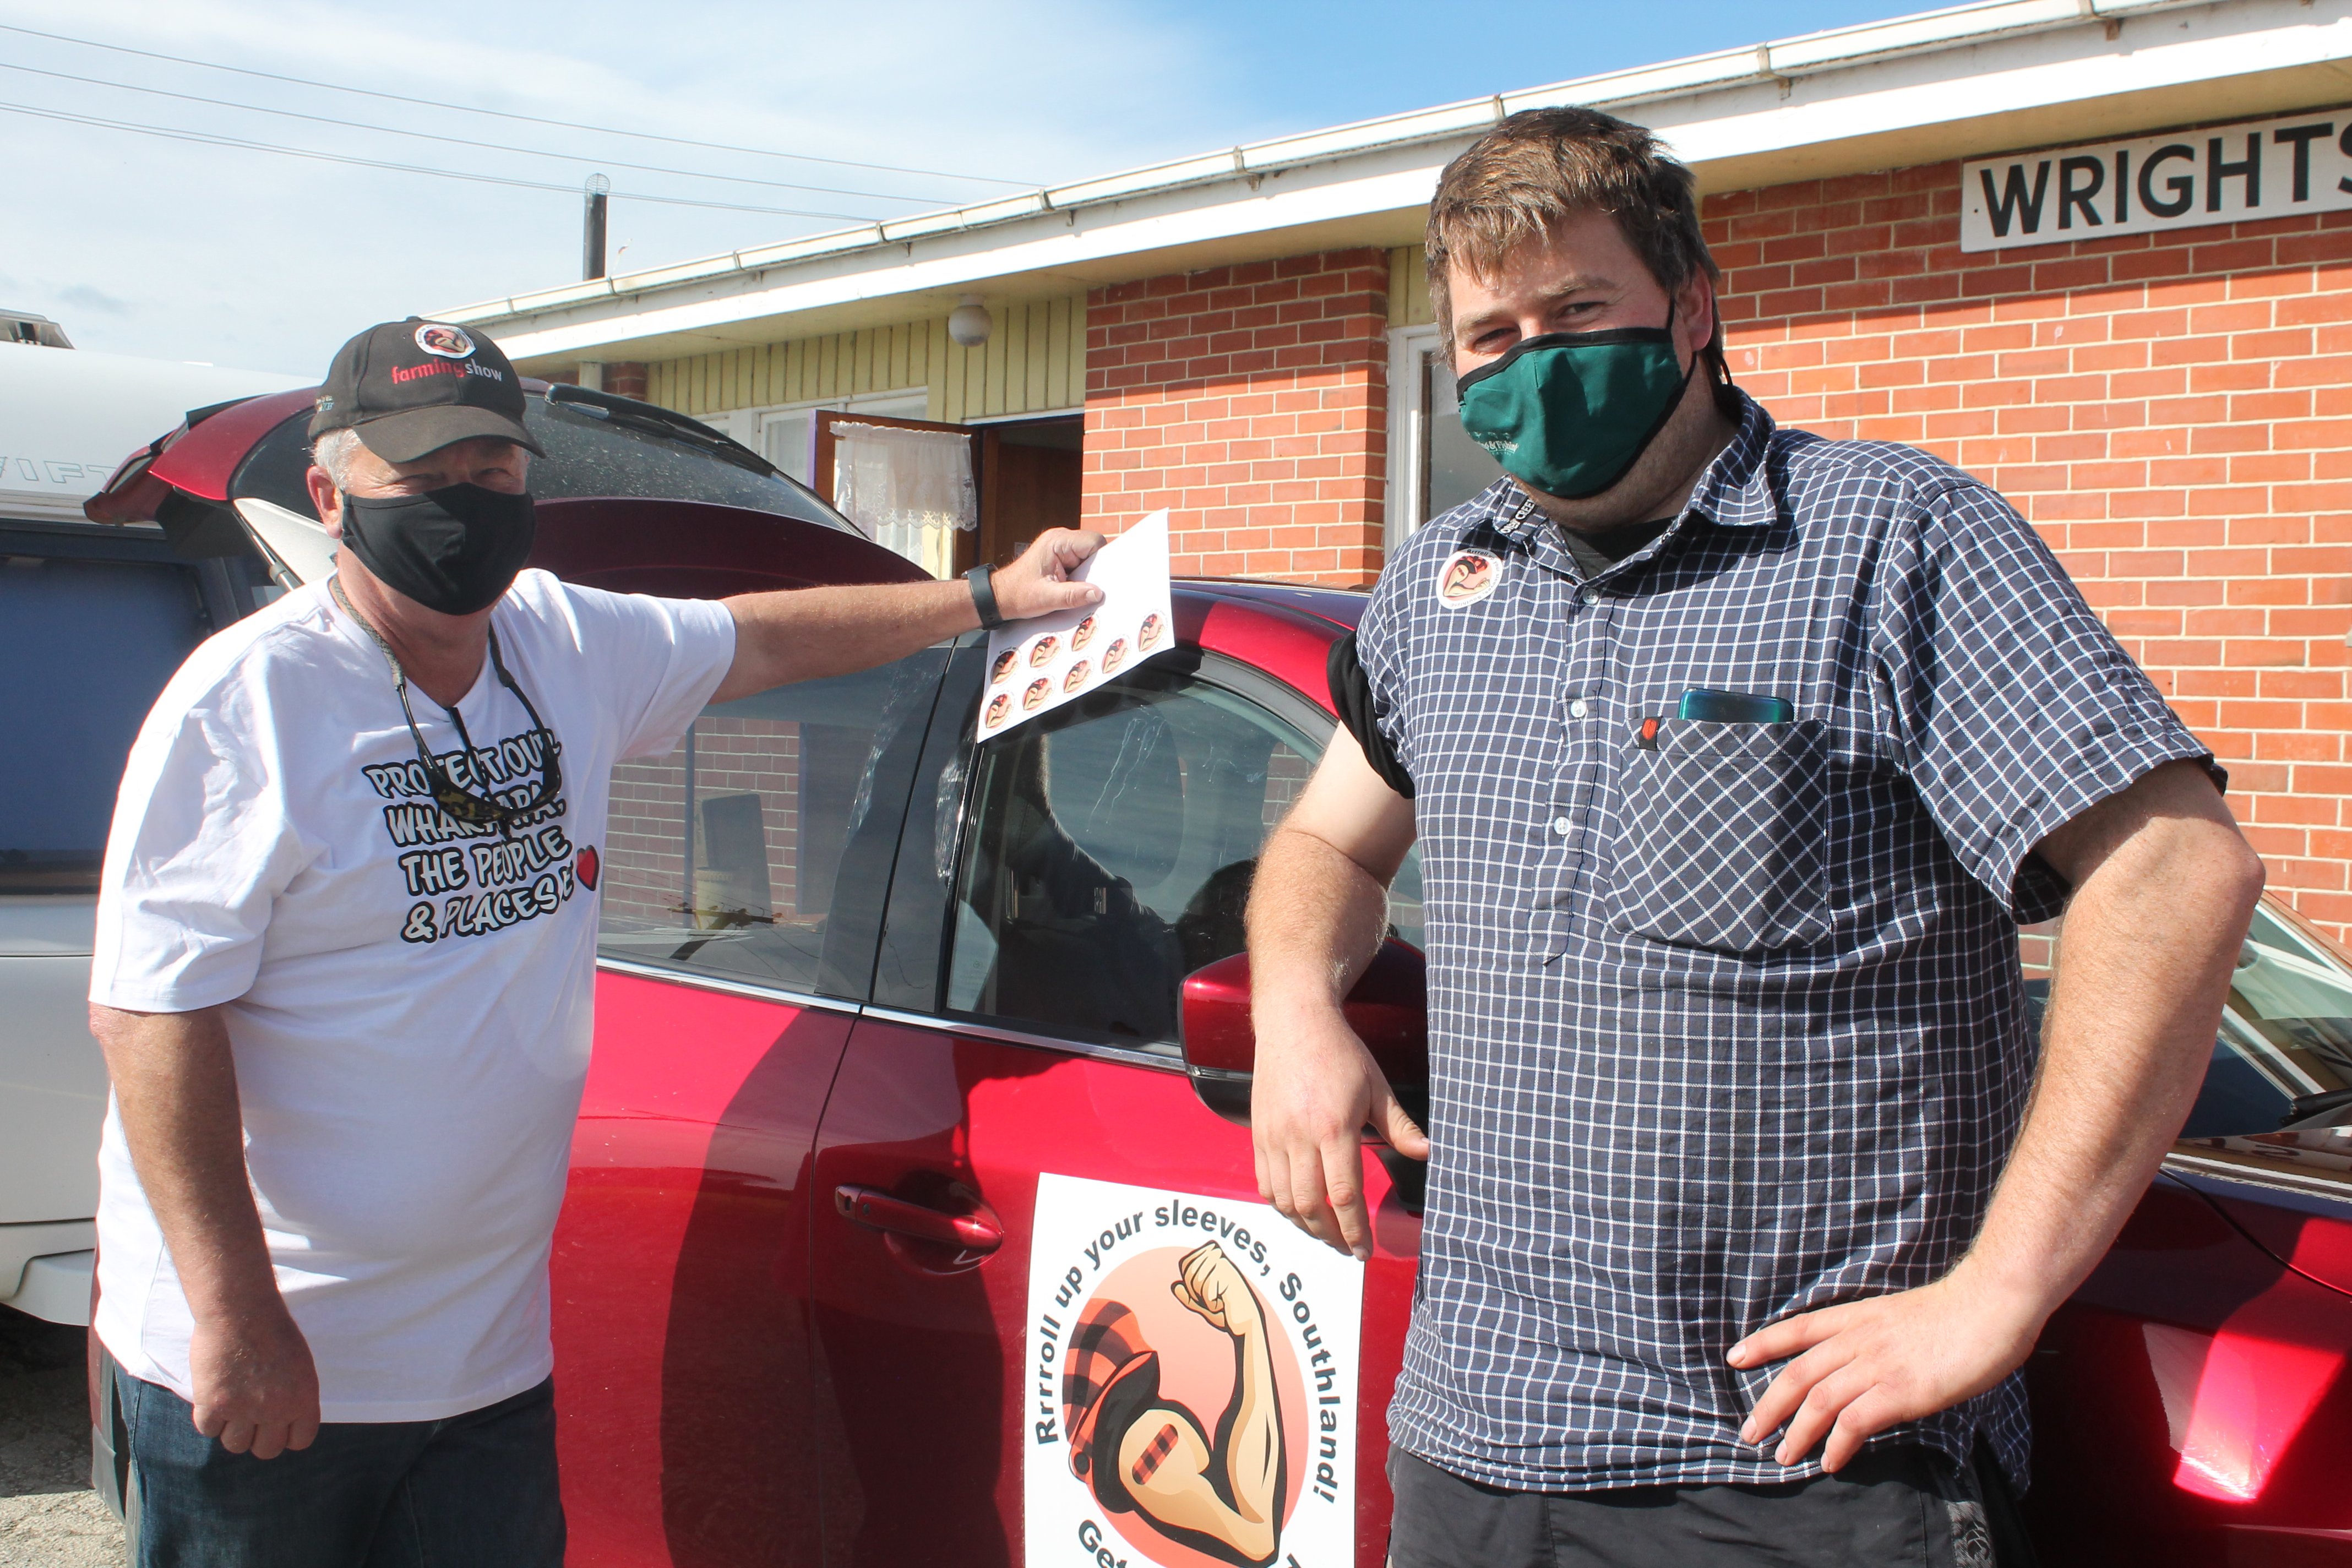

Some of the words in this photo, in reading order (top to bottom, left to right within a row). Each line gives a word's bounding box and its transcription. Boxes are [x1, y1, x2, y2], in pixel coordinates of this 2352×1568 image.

[398, 846, 470, 896] THE
[470, 825, 573, 888] PEOPLE
[401, 901, 438, 944] &
[439, 873, 559, 939] PLACES
[1035, 1313, 1061, 1445] Rrrroll
[1055, 1266, 1082, 1309] up
[1084, 1211, 1144, 1271] your
[1155, 1199, 1271, 1277] sleeves,
[1279, 1272, 1341, 1504] Southland!
